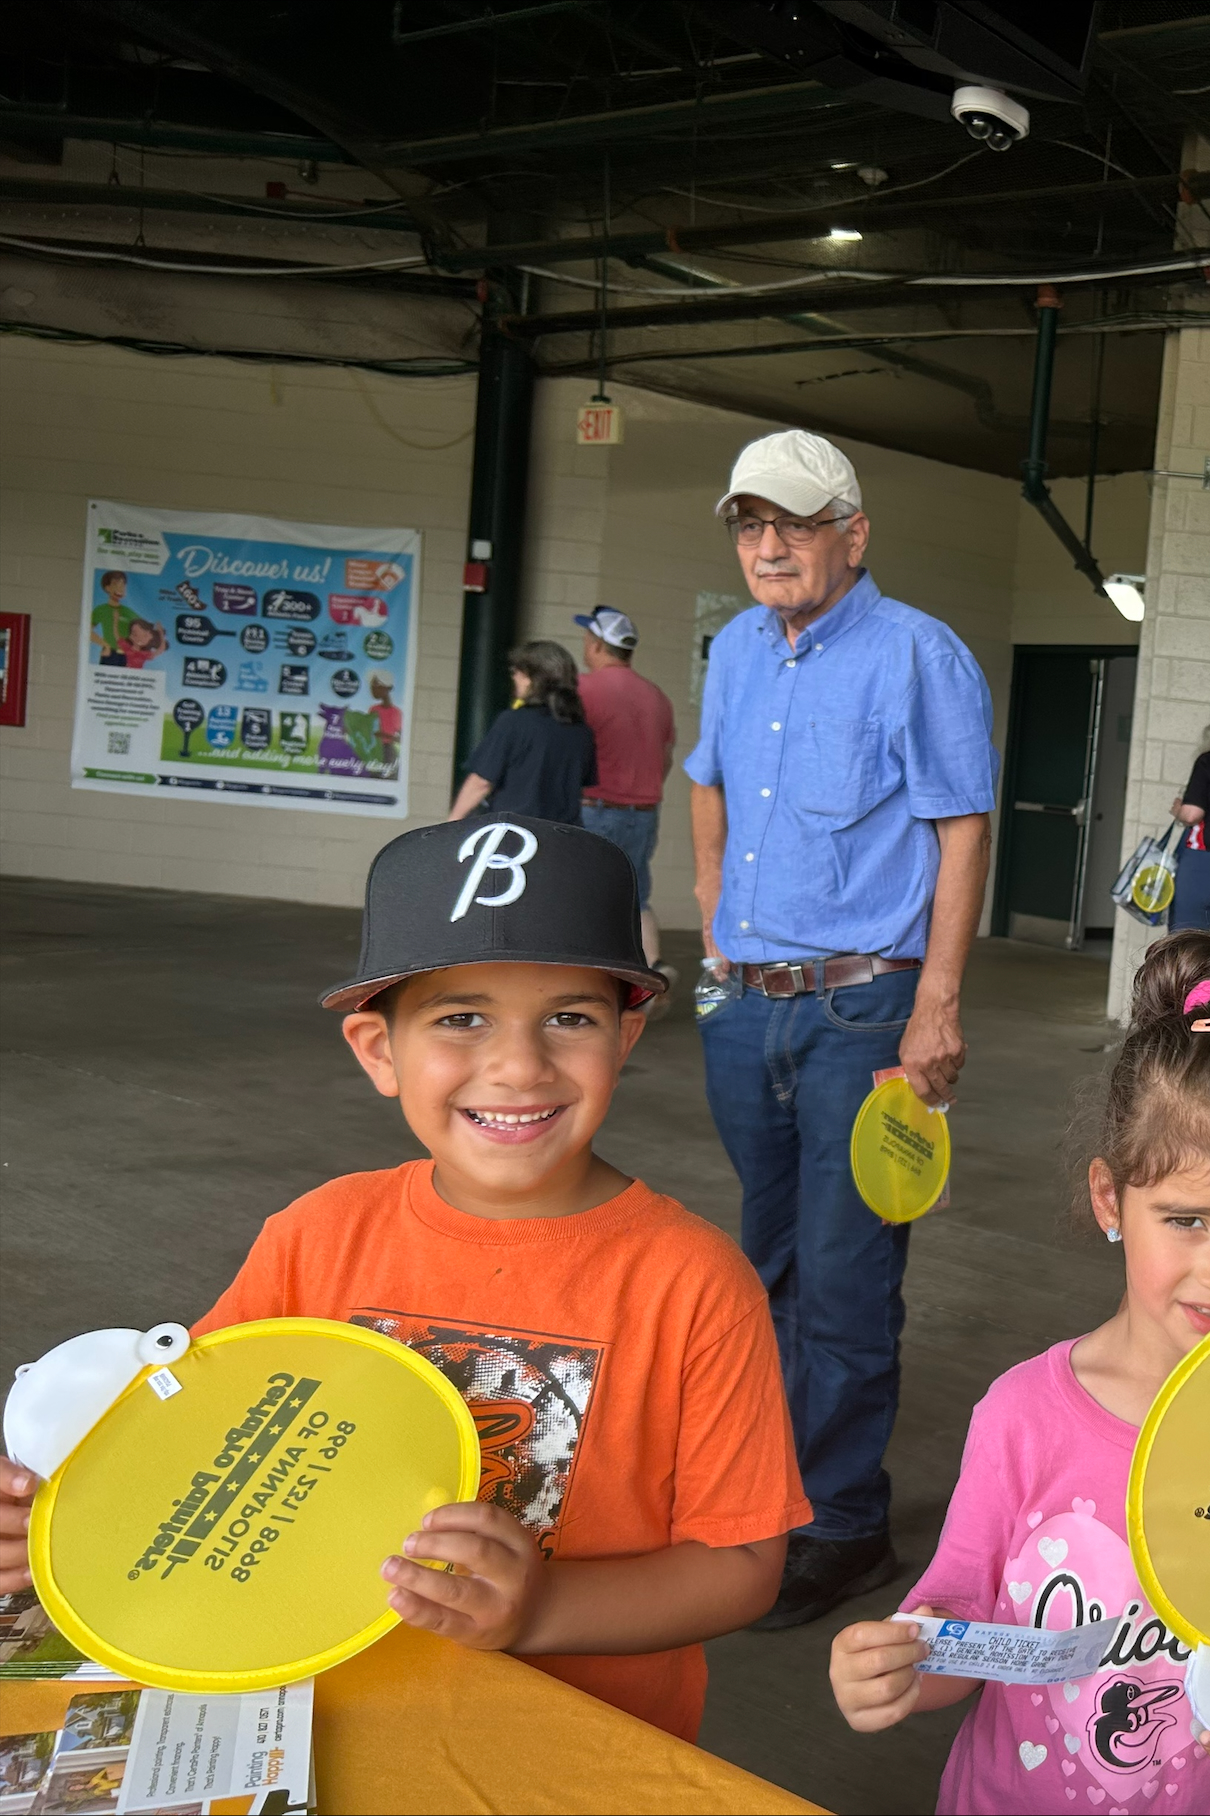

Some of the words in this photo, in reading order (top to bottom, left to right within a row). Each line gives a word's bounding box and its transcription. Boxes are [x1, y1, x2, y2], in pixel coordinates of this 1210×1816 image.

[584, 409, 613, 440] EXIT
[177, 545, 289, 579] Discover
[293, 556, 332, 584] us!
[450, 822, 539, 922] B
[955, 1640, 987, 1650] PRESENT
[1018, 1648, 1034, 1656] GATE
[988, 1636, 1011, 1646] CHILD
[1013, 1639, 1040, 1649] TICKET
[948, 1652, 980, 1661] REGULAR
[982, 1656, 1008, 1664] SEASON
[1012, 1659, 1029, 1667] HOME
[956, 1648, 986, 1656] GENERAL
[989, 1651, 1028, 1660] ADMISSION
[146, 1768, 161, 1798] Professional
[156, 1716, 170, 1745] Transparent
[188, 1754, 200, 1776] CertaPro
[206, 1753, 220, 1774] Painting
[244, 1750, 268, 1788] Painting
[262, 1754, 285, 1786] Happy
[166, 1765, 179, 1796] Convenient
[184, 1776, 196, 1792] That's
[204, 1774, 214, 1790] That's
